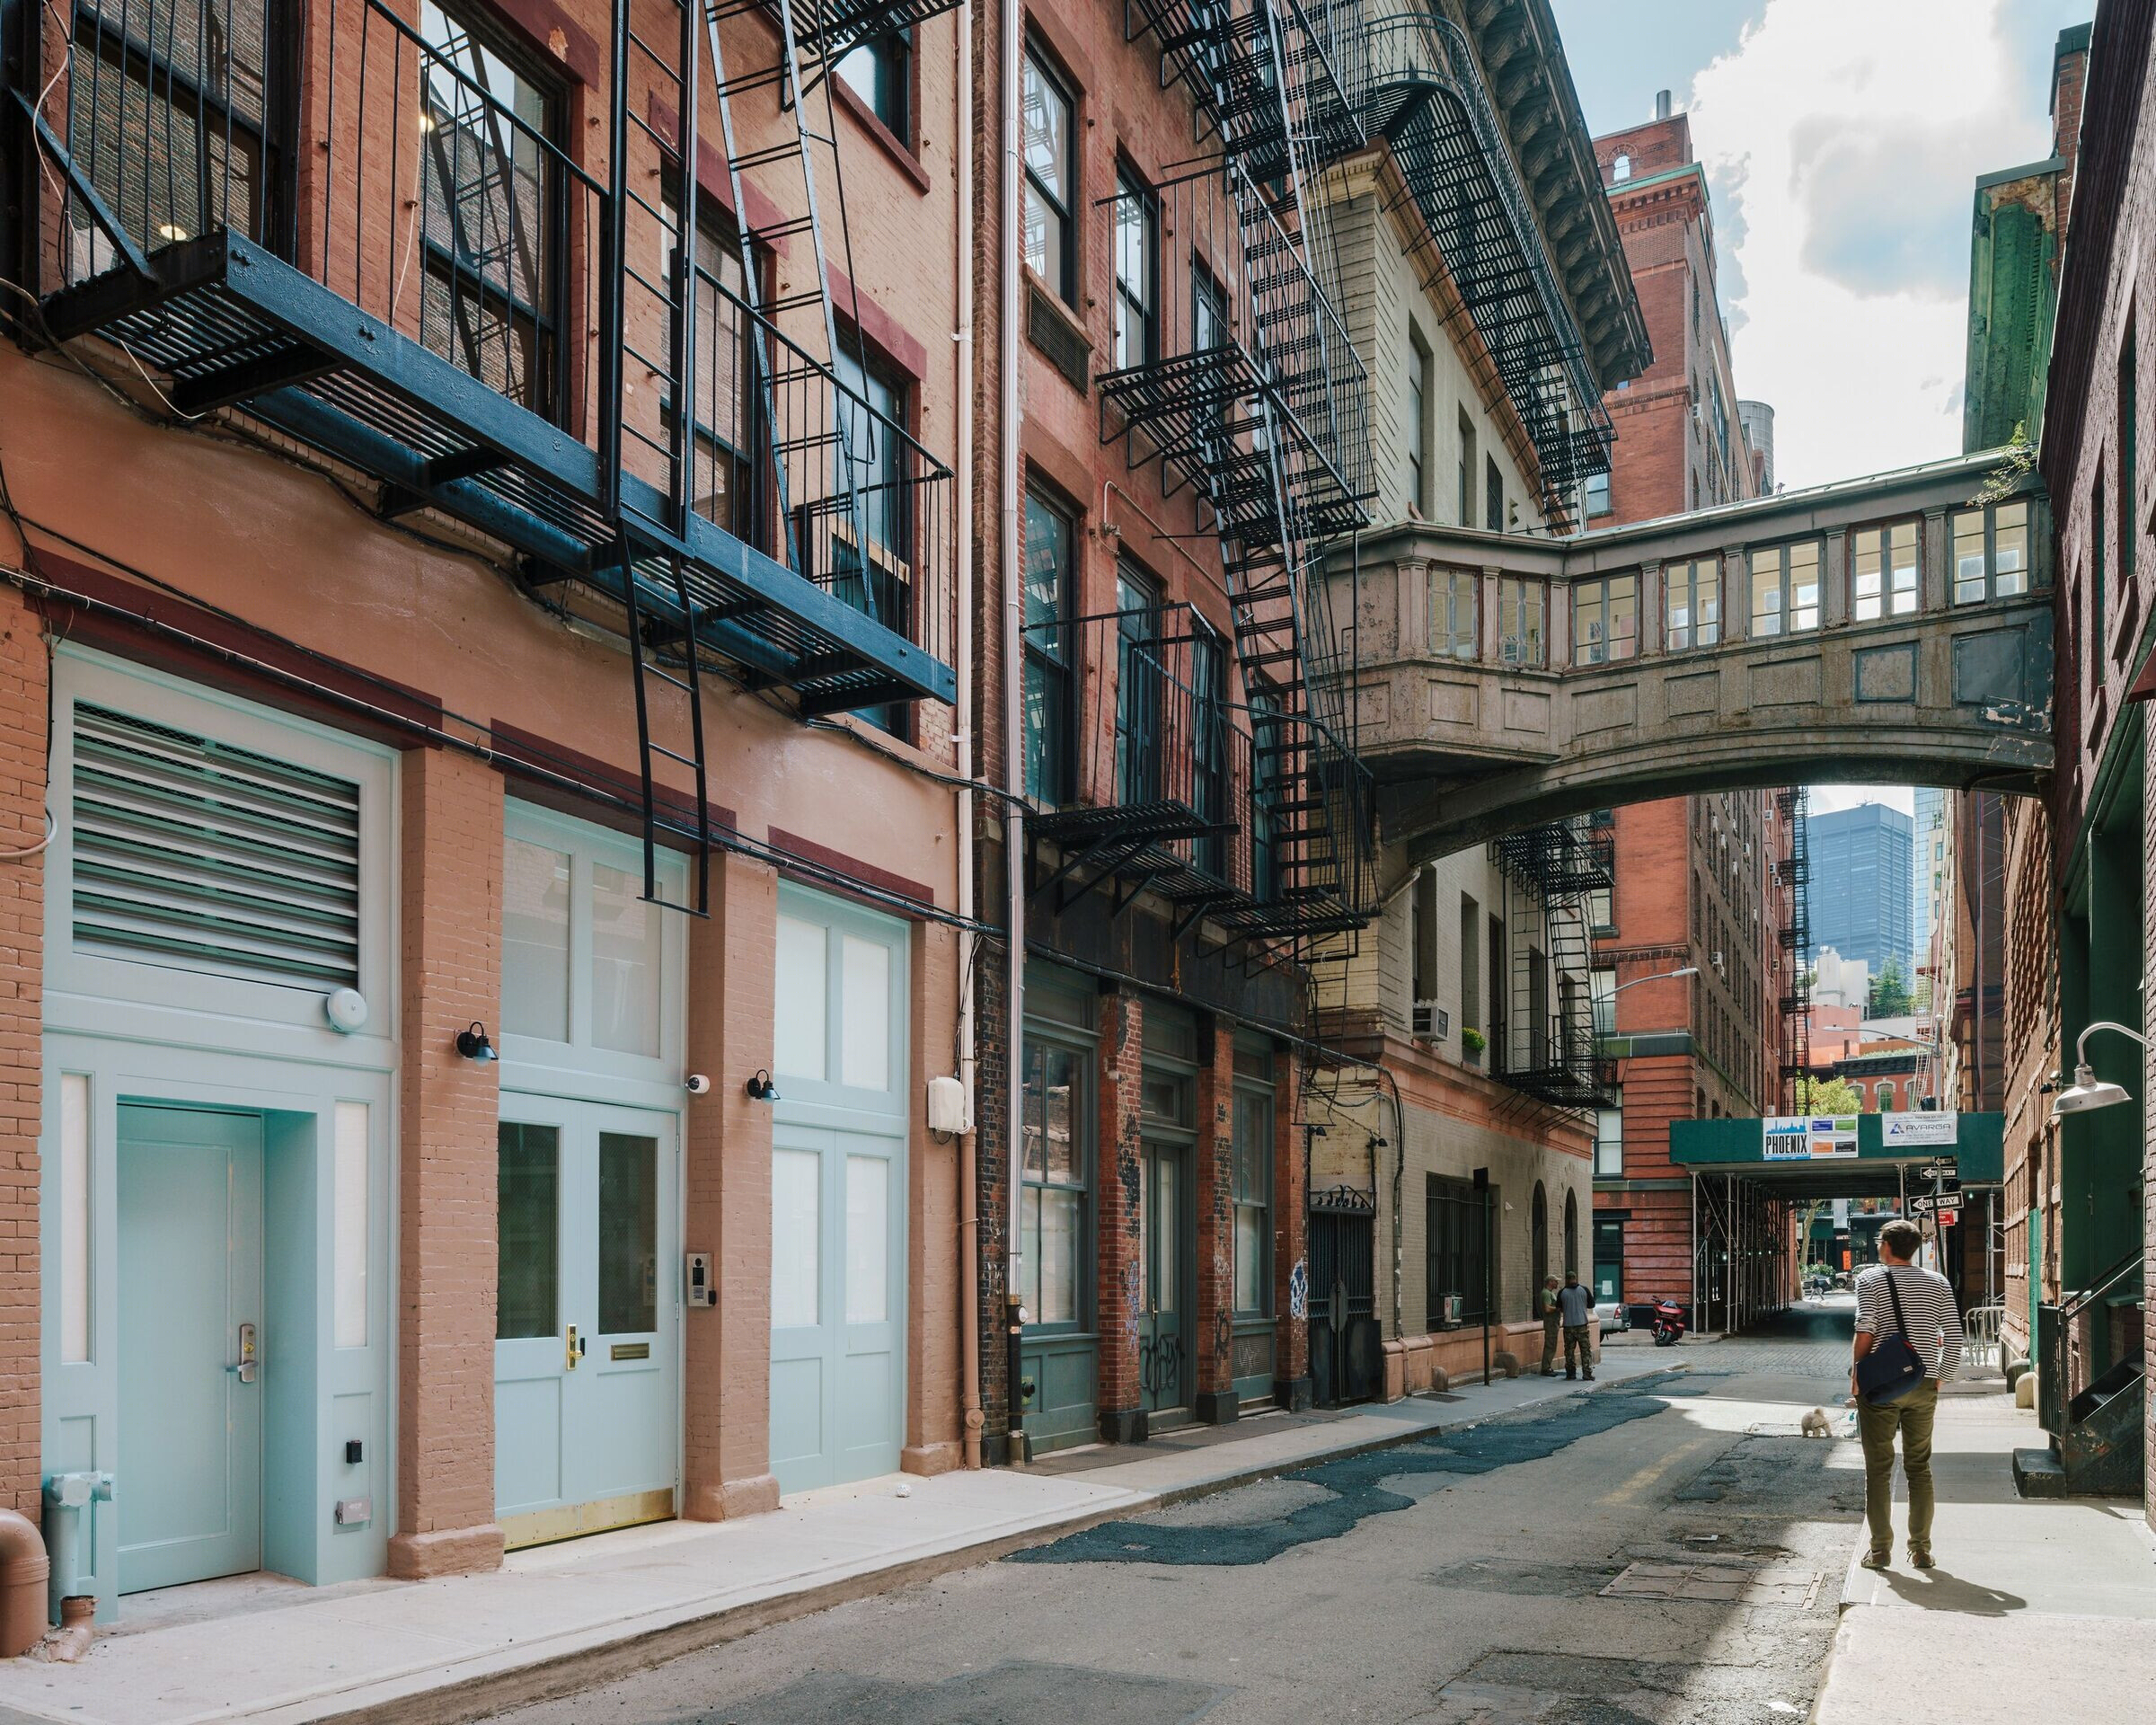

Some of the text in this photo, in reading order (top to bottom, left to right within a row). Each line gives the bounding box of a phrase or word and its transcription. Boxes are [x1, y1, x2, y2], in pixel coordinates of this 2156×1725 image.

[1765, 1135, 1807, 1154] PHOENIX
[1917, 1197, 1956, 1208] ONE WAY
